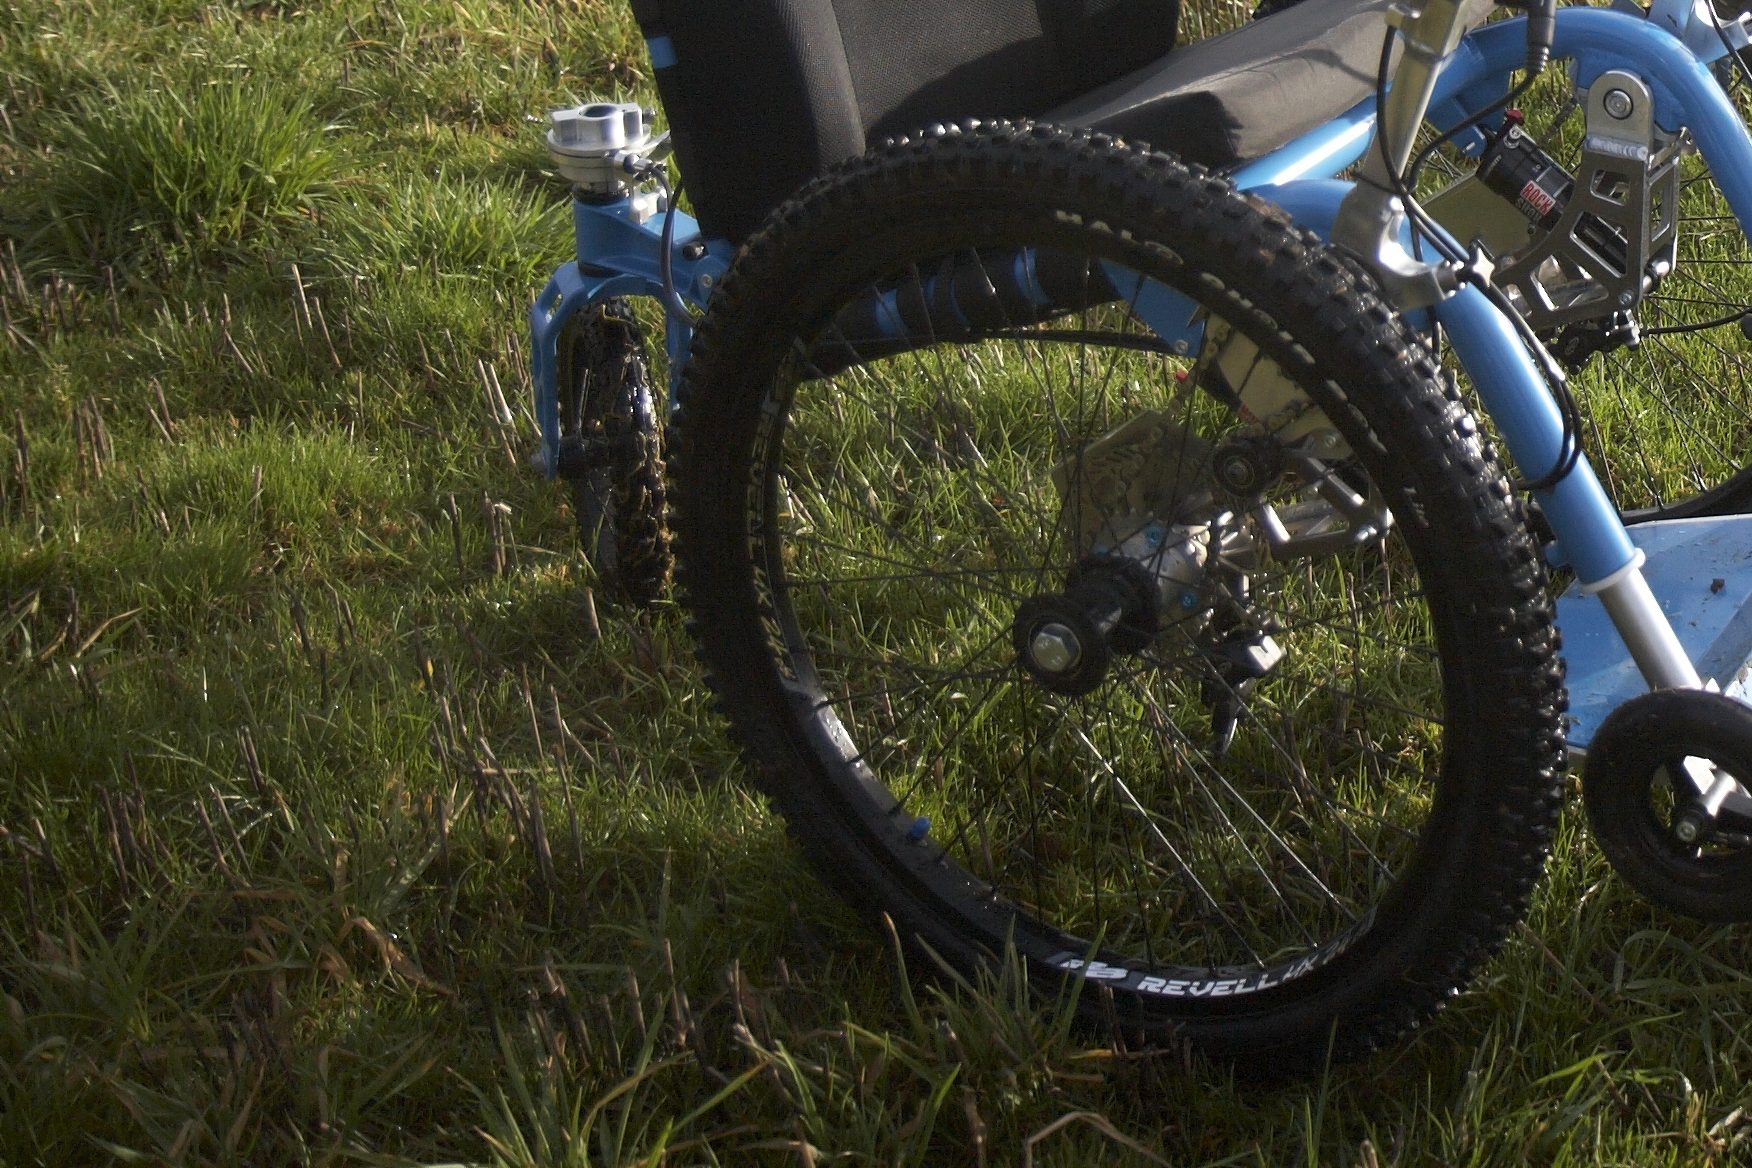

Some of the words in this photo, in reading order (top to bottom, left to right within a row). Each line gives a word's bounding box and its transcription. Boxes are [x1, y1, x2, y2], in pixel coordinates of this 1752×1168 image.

[1522, 182, 1554, 214] ROCK
[1056, 209, 1185, 266] HALO
[1137, 972, 1279, 996] REVELL
